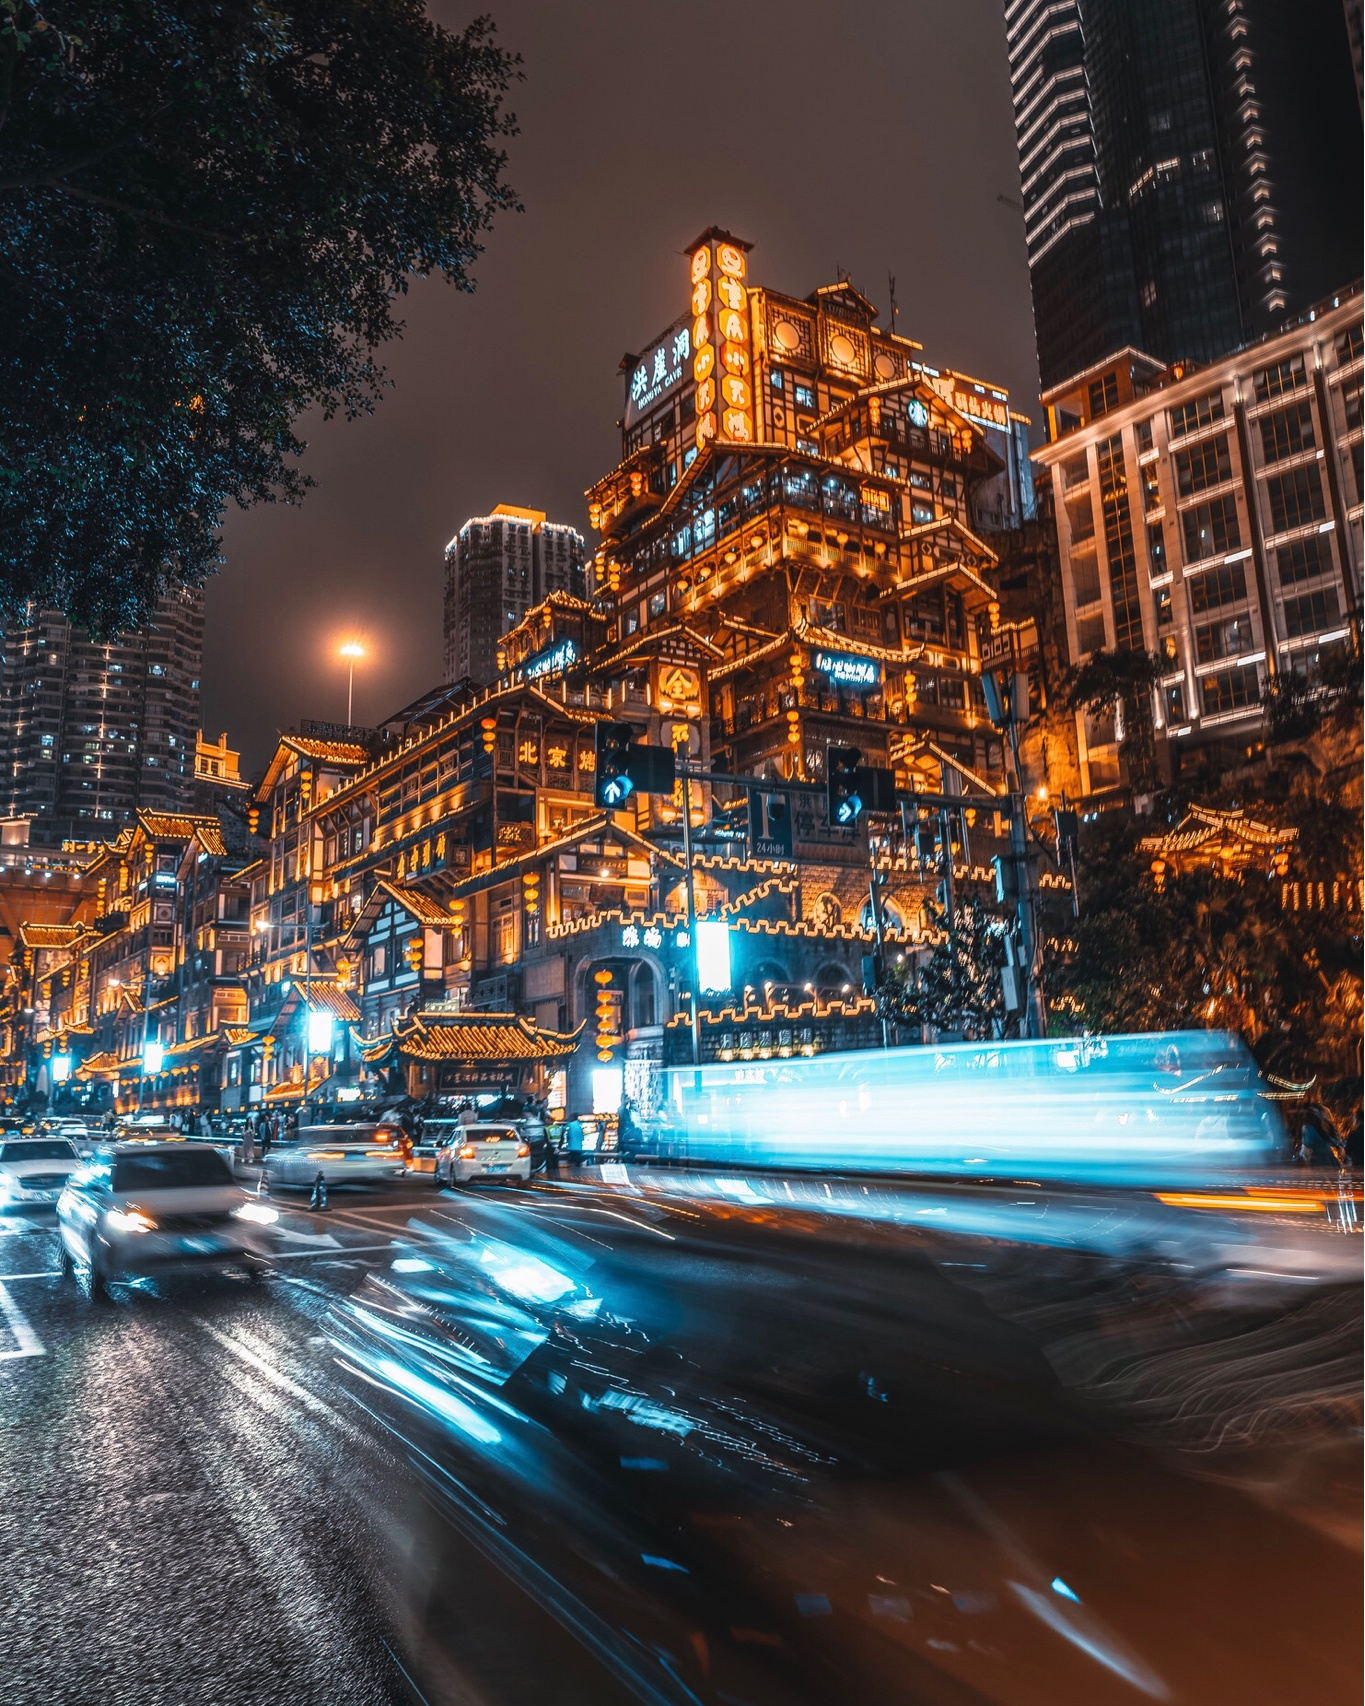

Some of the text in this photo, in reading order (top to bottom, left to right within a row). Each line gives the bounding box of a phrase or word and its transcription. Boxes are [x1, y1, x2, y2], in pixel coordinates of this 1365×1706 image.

[631, 328, 690, 402] 洪崖洞
[638, 384, 662, 411] HONGYA
[756, 842, 785, 856] 24小时
